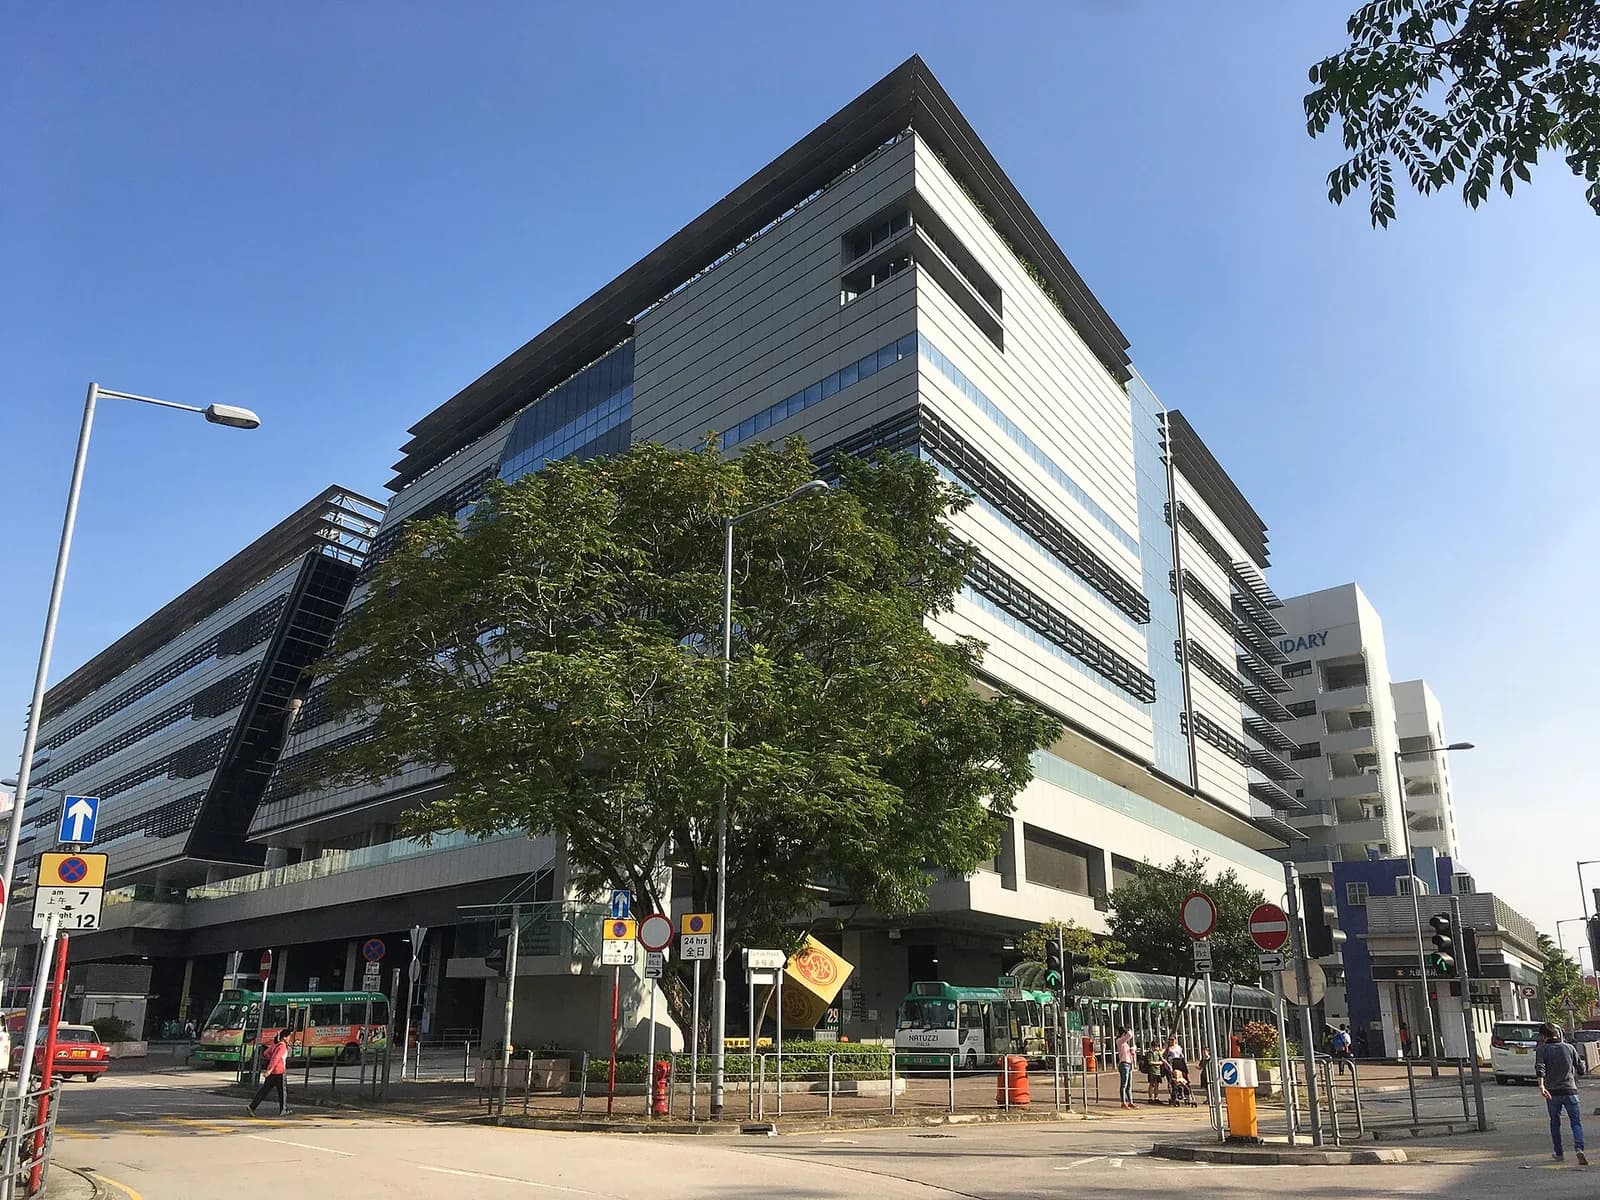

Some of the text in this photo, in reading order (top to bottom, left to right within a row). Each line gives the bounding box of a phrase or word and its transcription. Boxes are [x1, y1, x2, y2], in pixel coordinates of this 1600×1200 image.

[47, 897, 67, 905] 上午
[79, 892, 90, 905] 7
[76, 914, 96, 928] 12
[623, 941, 629, 950] 7
[686, 946, 705, 957] 全日
[623, 954, 633, 964] 12
[908, 1034, 939, 1042] NATUZZI
